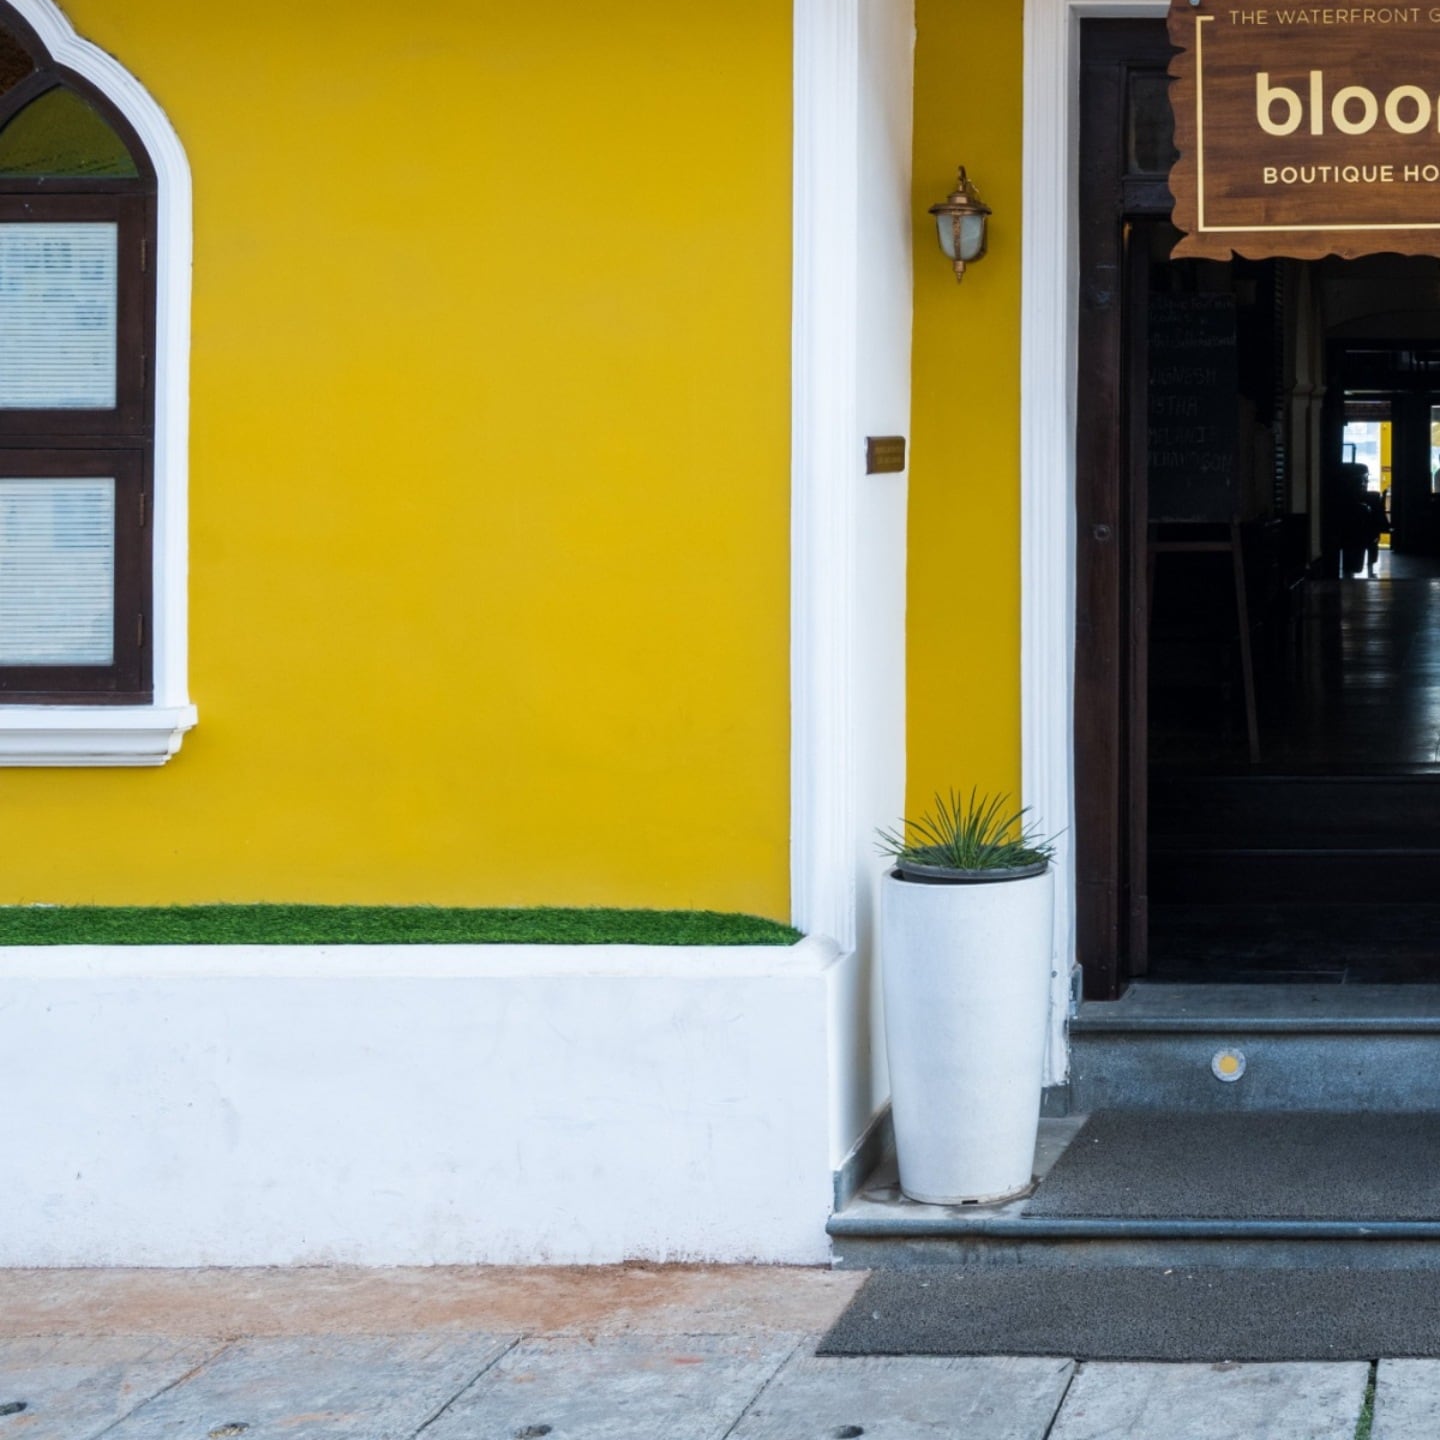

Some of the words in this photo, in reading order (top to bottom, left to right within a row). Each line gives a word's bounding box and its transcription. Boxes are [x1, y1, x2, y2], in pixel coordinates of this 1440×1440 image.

[1229, 9, 1268, 25] THE
[1275, 7, 1420, 25] WATERFRONT
[1263, 165, 1394, 185] BOUTIQUE
